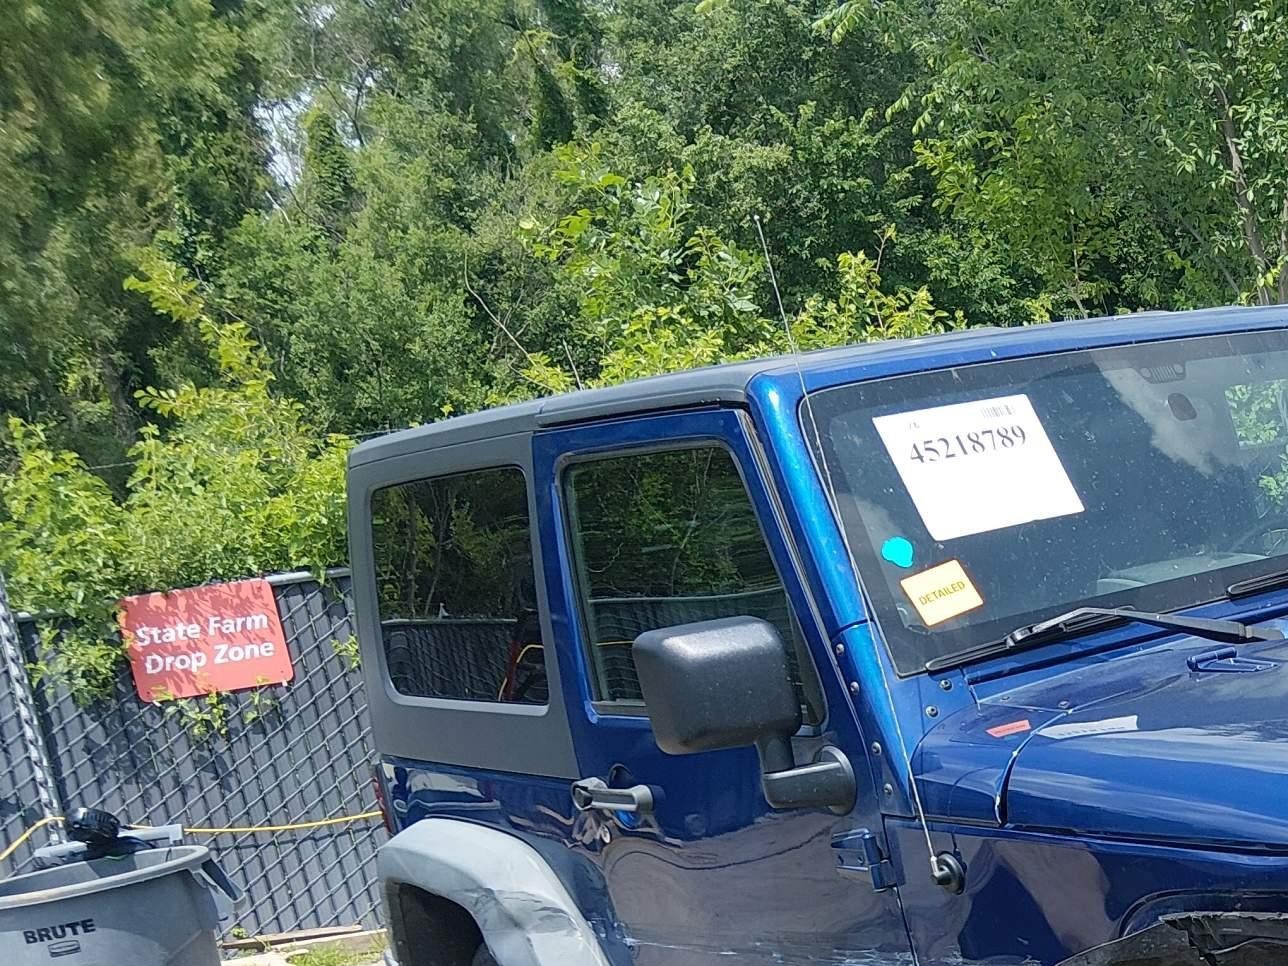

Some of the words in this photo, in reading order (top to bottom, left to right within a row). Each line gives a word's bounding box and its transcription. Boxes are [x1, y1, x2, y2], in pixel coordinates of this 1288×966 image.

[910, 425, 1026, 463] 45218789
[919, 581, 966, 605] DETAILED
[136, 622, 200, 647] State
[208, 613, 268, 637] Farm
[144, 651, 207, 675] Drop
[213, 641, 275, 665] Zone
[23, 918, 96, 945] BRUTE
